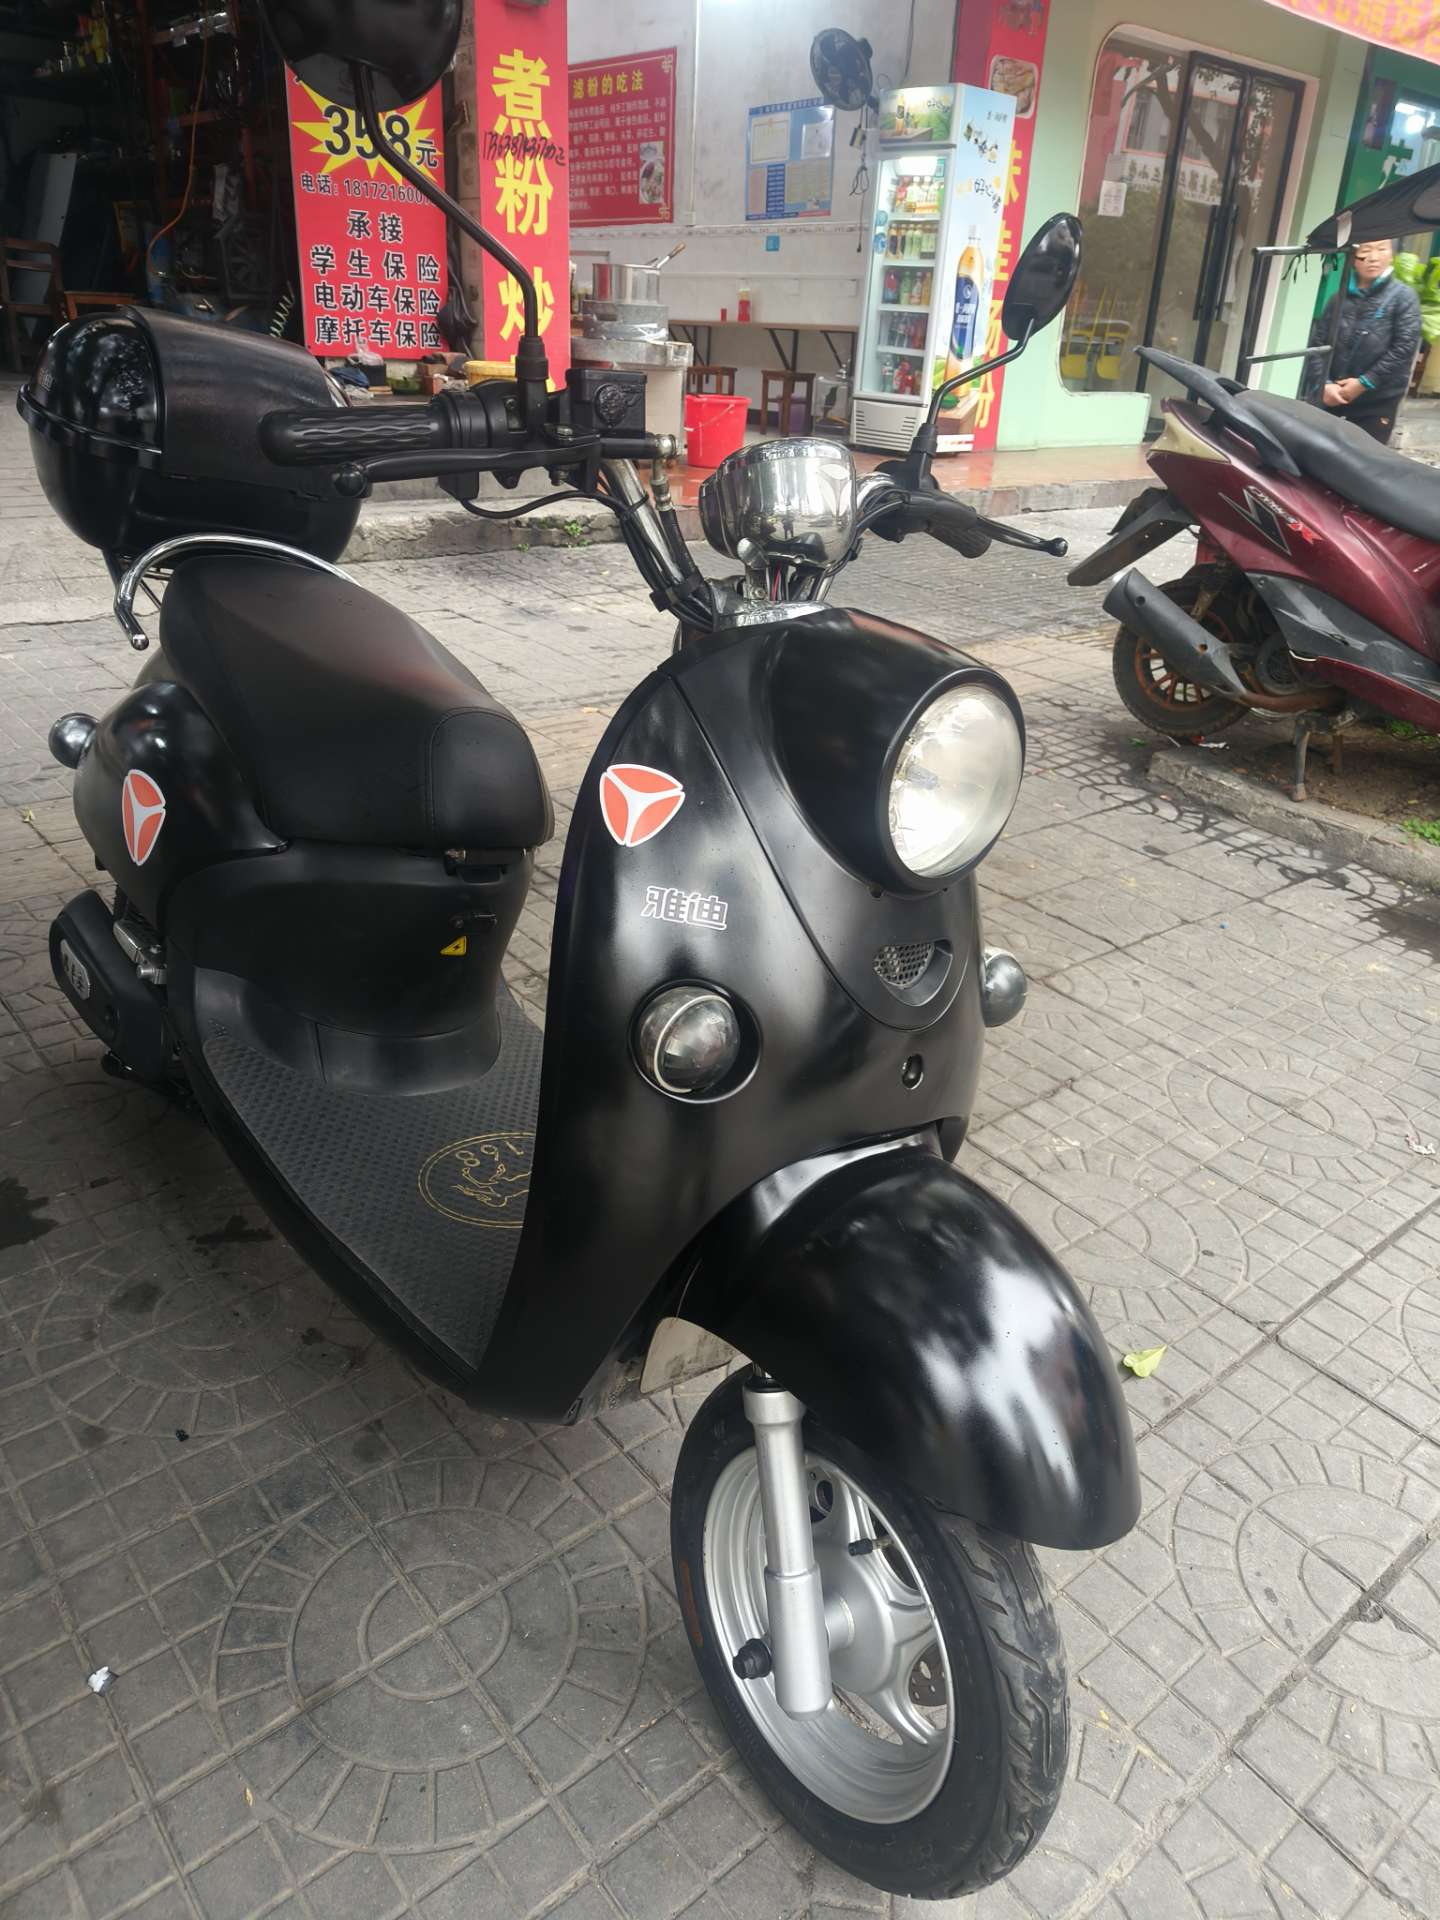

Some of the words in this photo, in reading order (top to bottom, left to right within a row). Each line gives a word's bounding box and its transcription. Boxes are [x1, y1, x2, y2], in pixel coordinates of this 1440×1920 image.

[348, 209, 402, 242] 承接
[311, 245, 440, 283] 学生保险
[314, 282, 442, 317] 电动车保险
[315, 316, 442, 349] 摩托车保险
[641, 885, 728, 931] 雅迪
